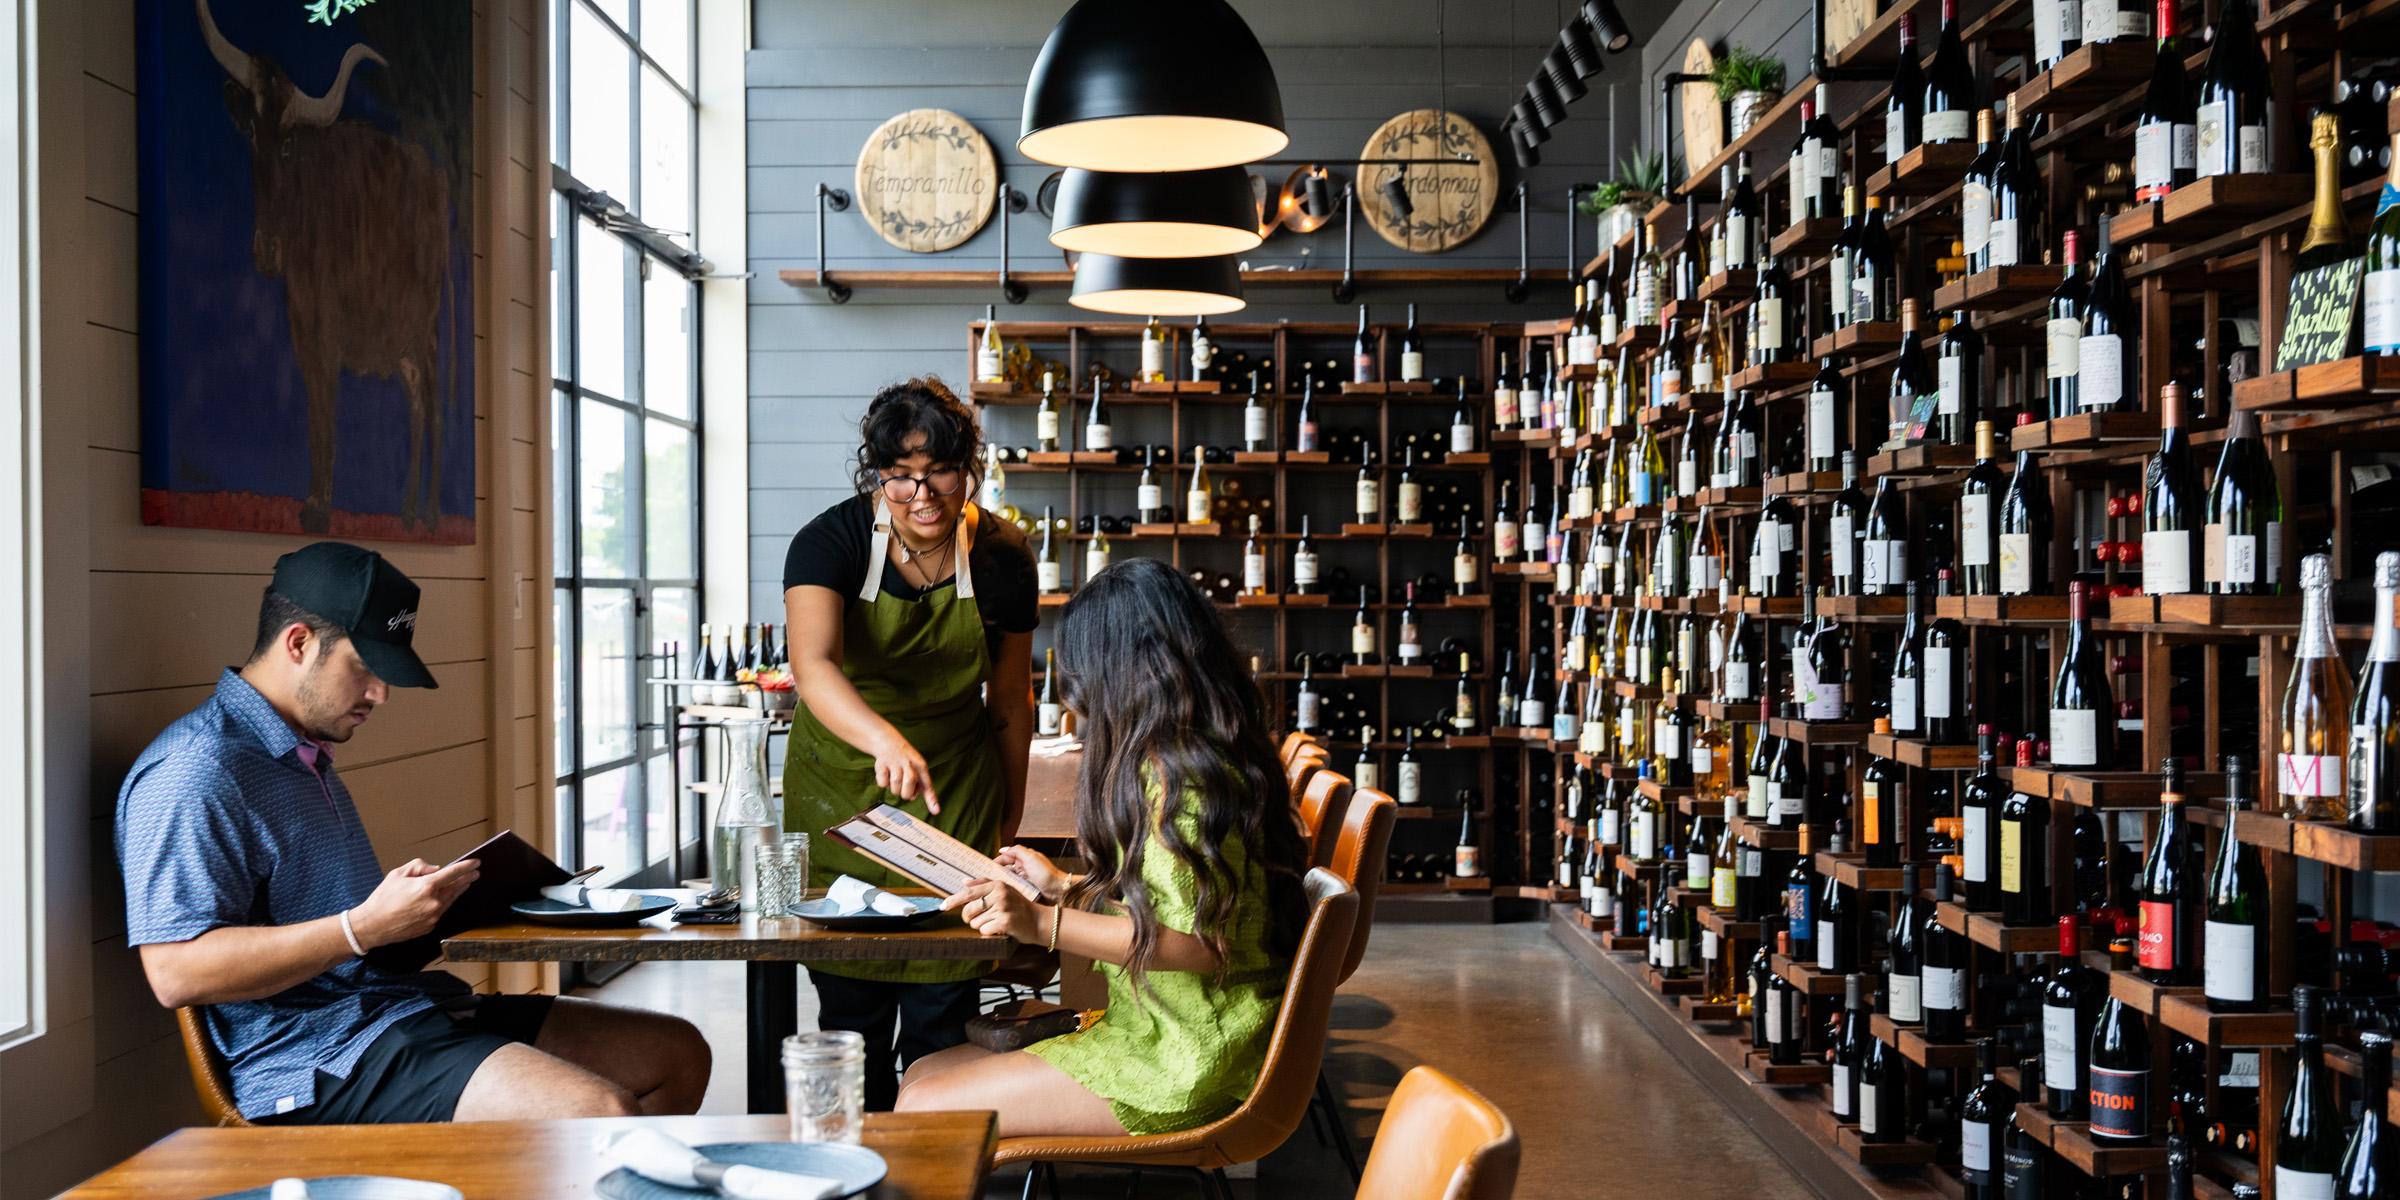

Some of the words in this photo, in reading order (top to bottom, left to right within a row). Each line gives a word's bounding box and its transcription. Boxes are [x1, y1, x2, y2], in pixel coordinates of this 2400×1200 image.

[863, 165, 985, 204] Tempranillo
[1373, 166, 1482, 209] Crdonnay
[2284, 291, 2351, 361] Sparkling
